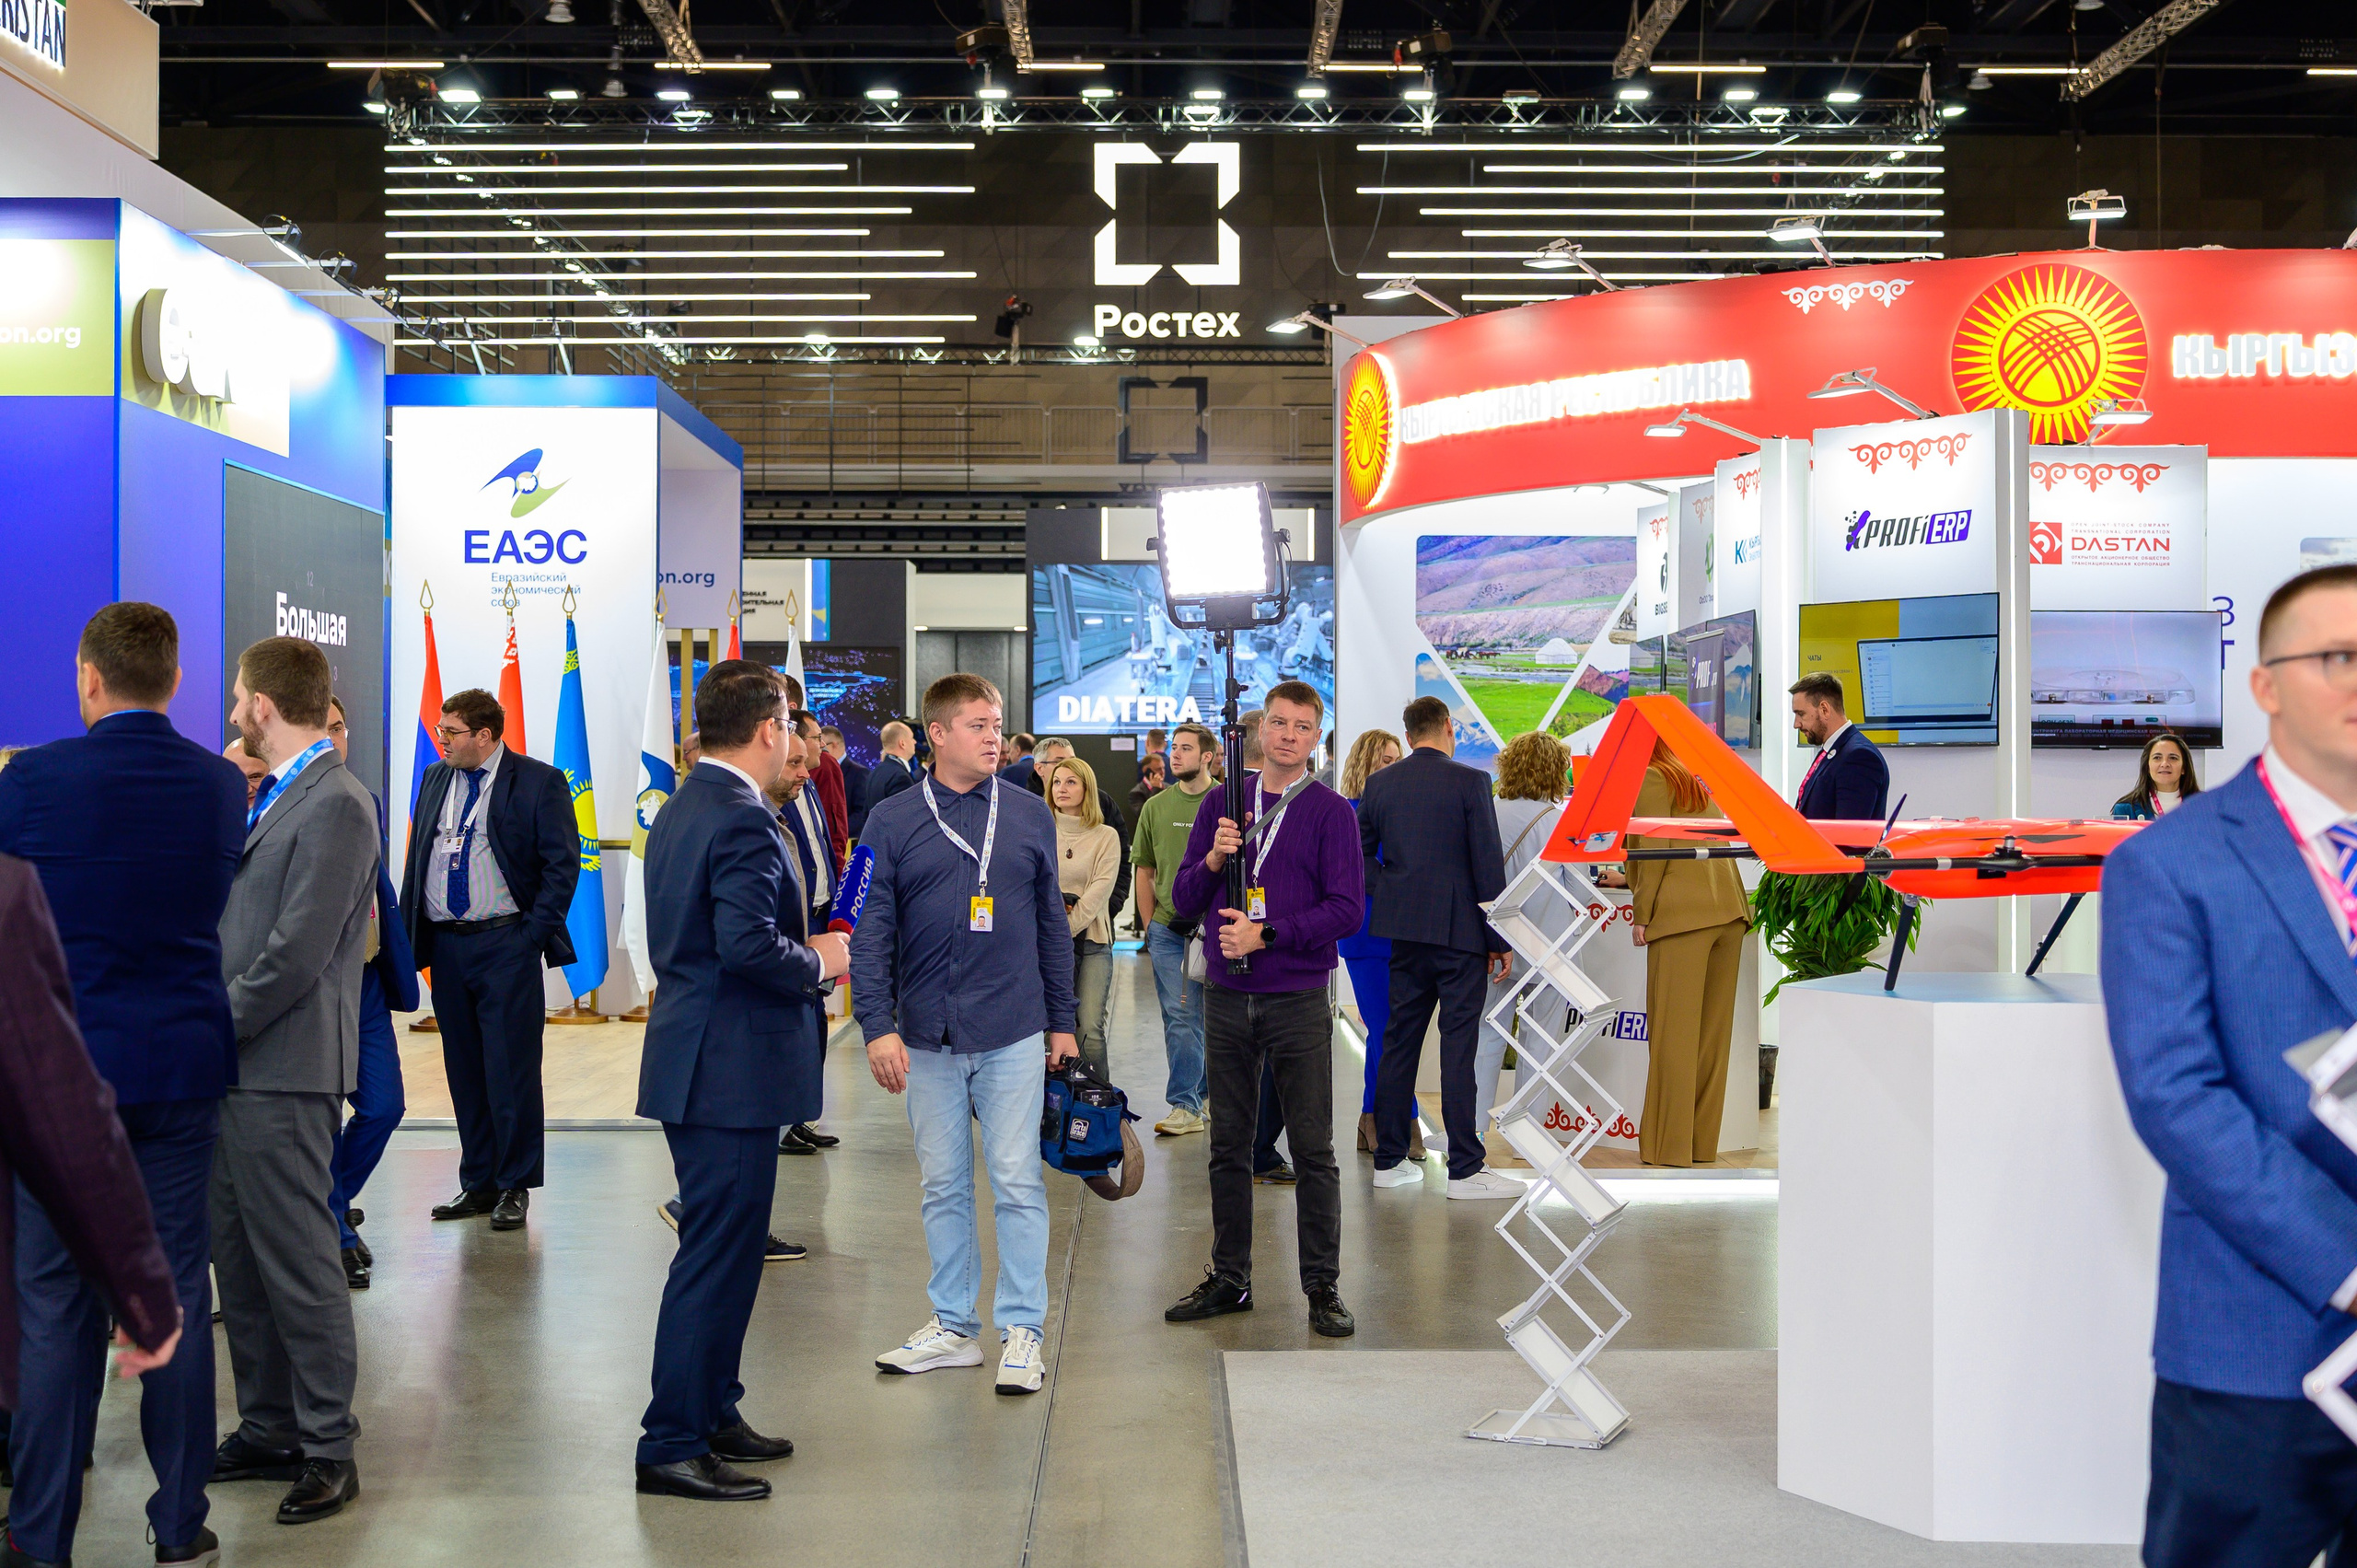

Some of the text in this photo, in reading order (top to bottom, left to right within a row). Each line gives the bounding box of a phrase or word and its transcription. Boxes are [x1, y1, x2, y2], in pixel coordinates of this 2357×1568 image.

[1094, 304, 1241, 338] Ростех
[464, 529, 587, 564] ЕАЭС
[2072, 537, 2170, 552] DASTAN
[491, 572, 567, 583] Евразийский
[491, 585, 581, 594] экономический
[276, 591, 347, 646] Большая
[1059, 695, 1202, 723] DIATERA
[831, 853, 857, 912] РОССИЯ
[850, 856, 874, 919] РОССИЯ
